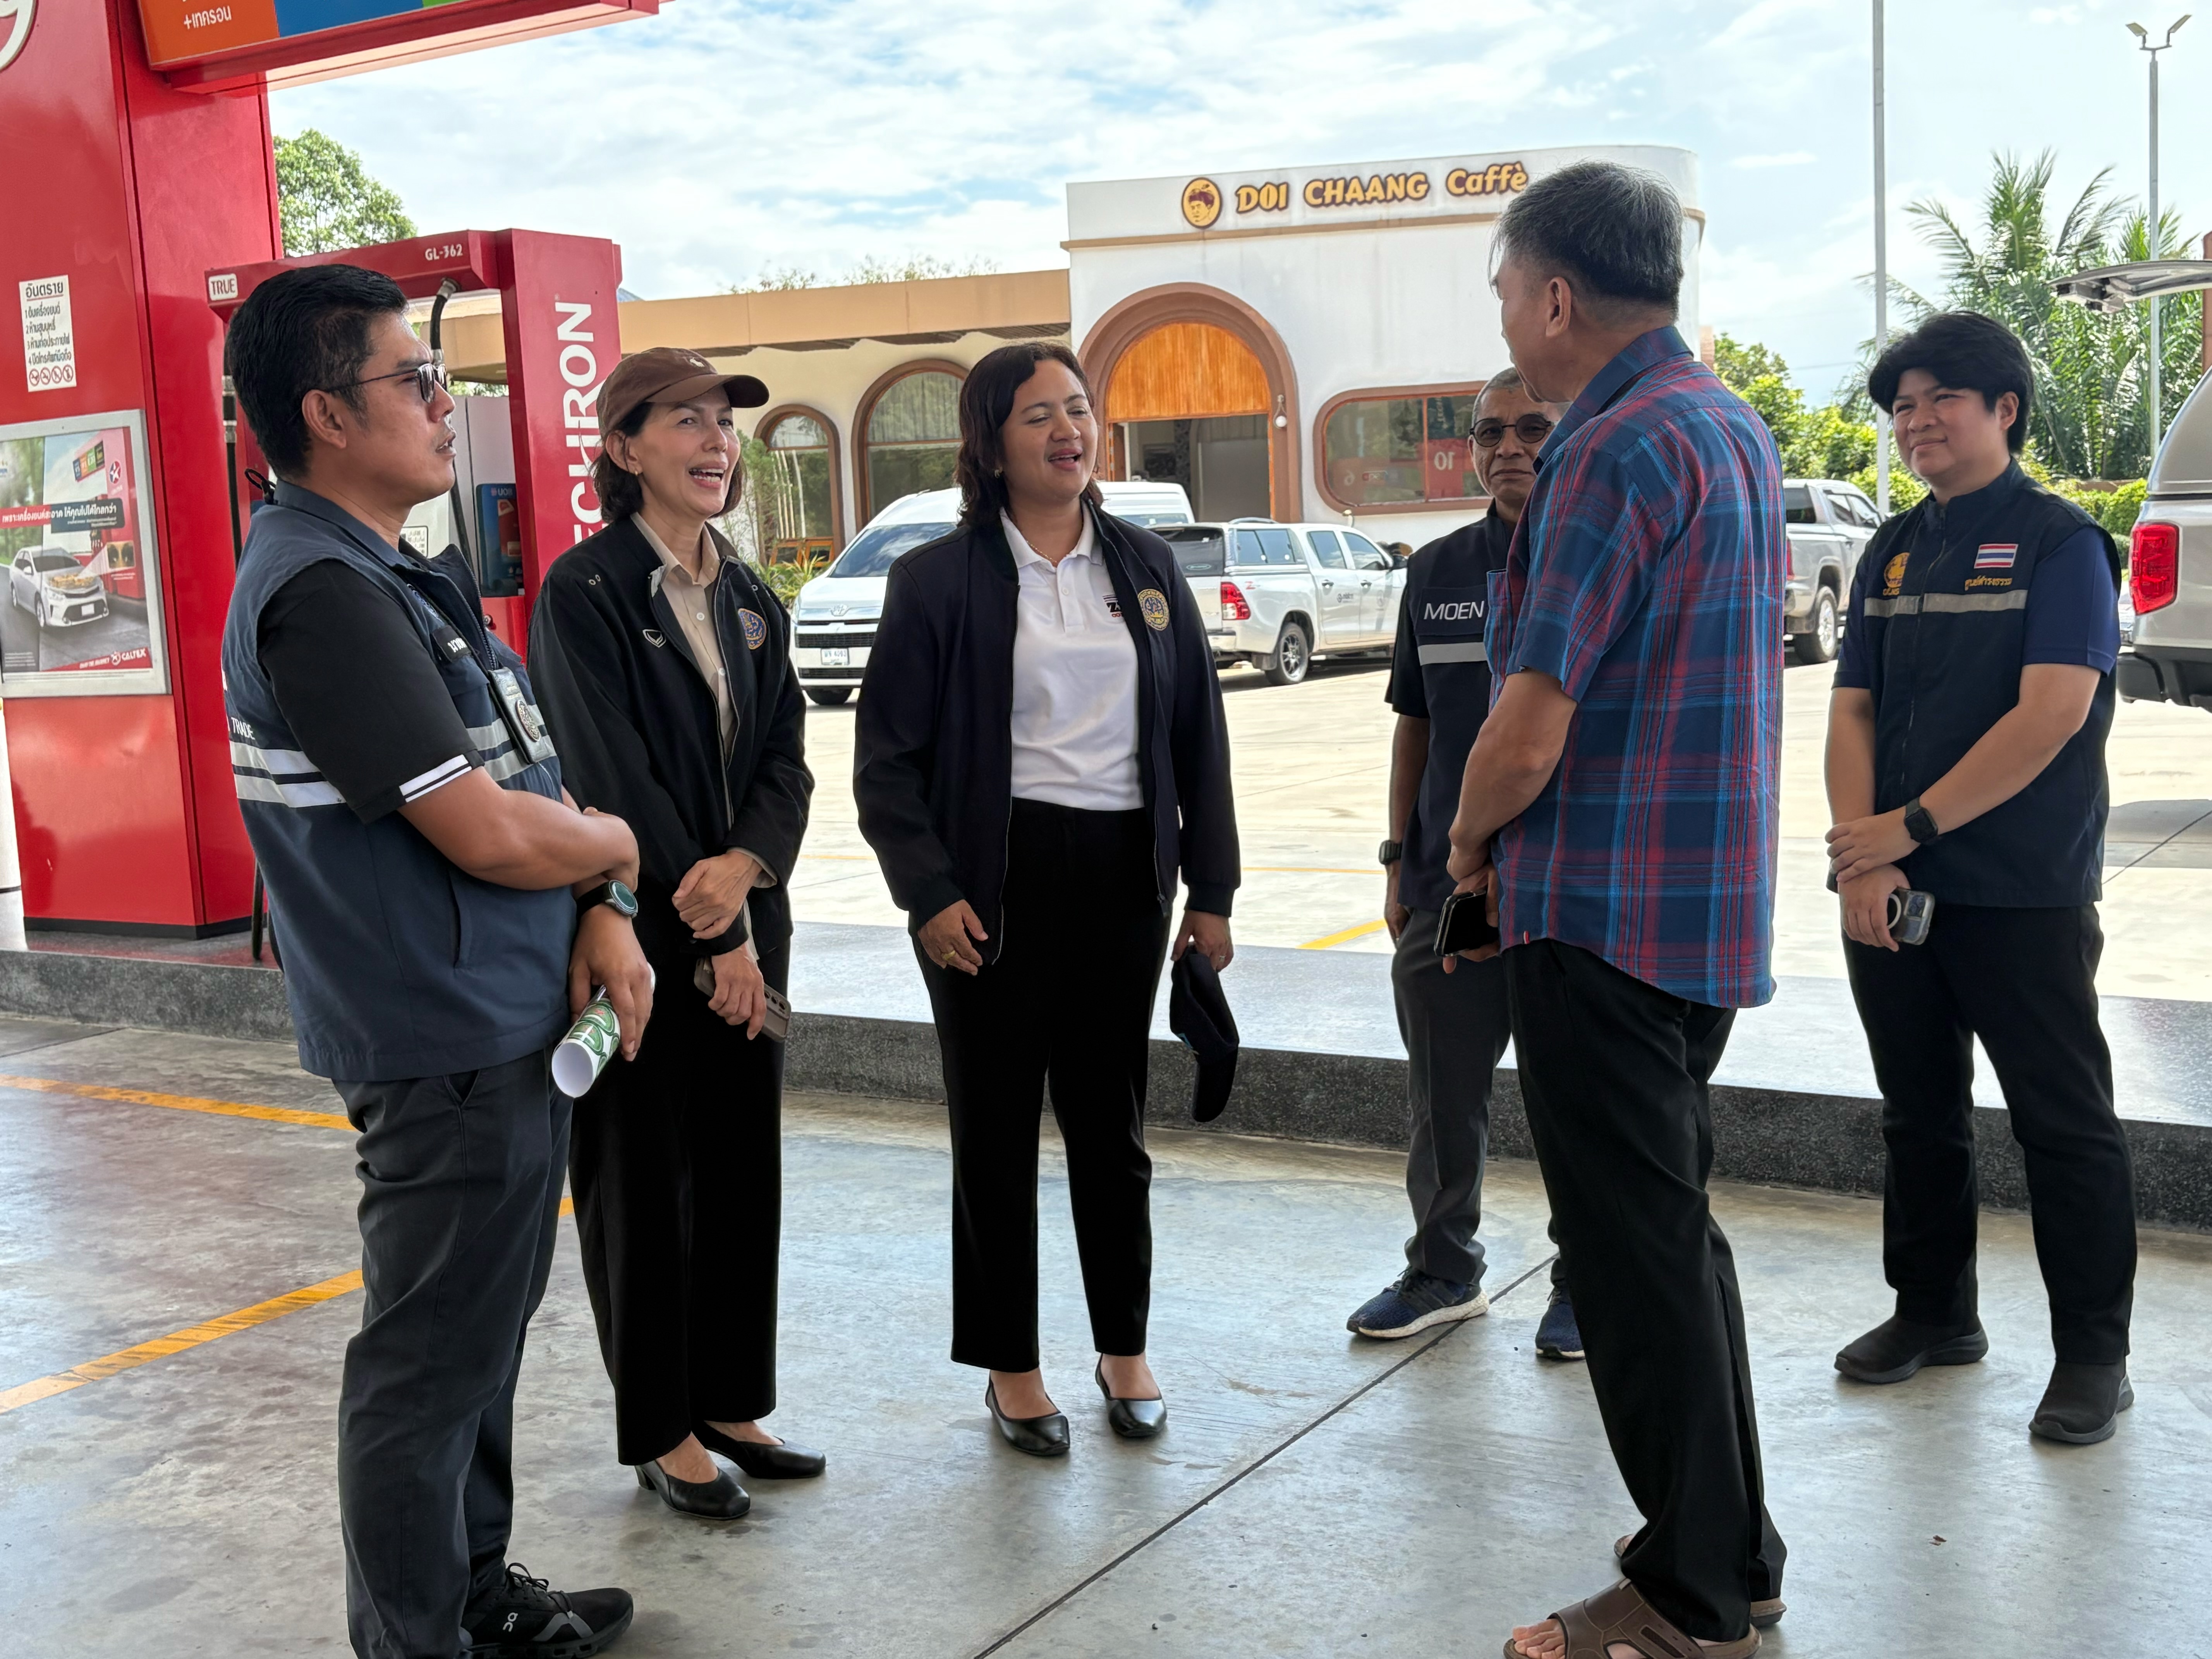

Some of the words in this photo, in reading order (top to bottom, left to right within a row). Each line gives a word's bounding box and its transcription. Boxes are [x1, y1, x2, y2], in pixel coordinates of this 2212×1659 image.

[1236, 182, 1289, 213] DOI
[1304, 172, 1430, 207] CHAANG
[1446, 161, 1528, 197] Caffè
[425, 244, 463, 261] GL-362
[25, 282, 64, 298] อันตราย
[211, 278, 236, 295] TRUE
[1424, 601, 1485, 620] MOEN
[231, 717, 256, 740] TRADE
